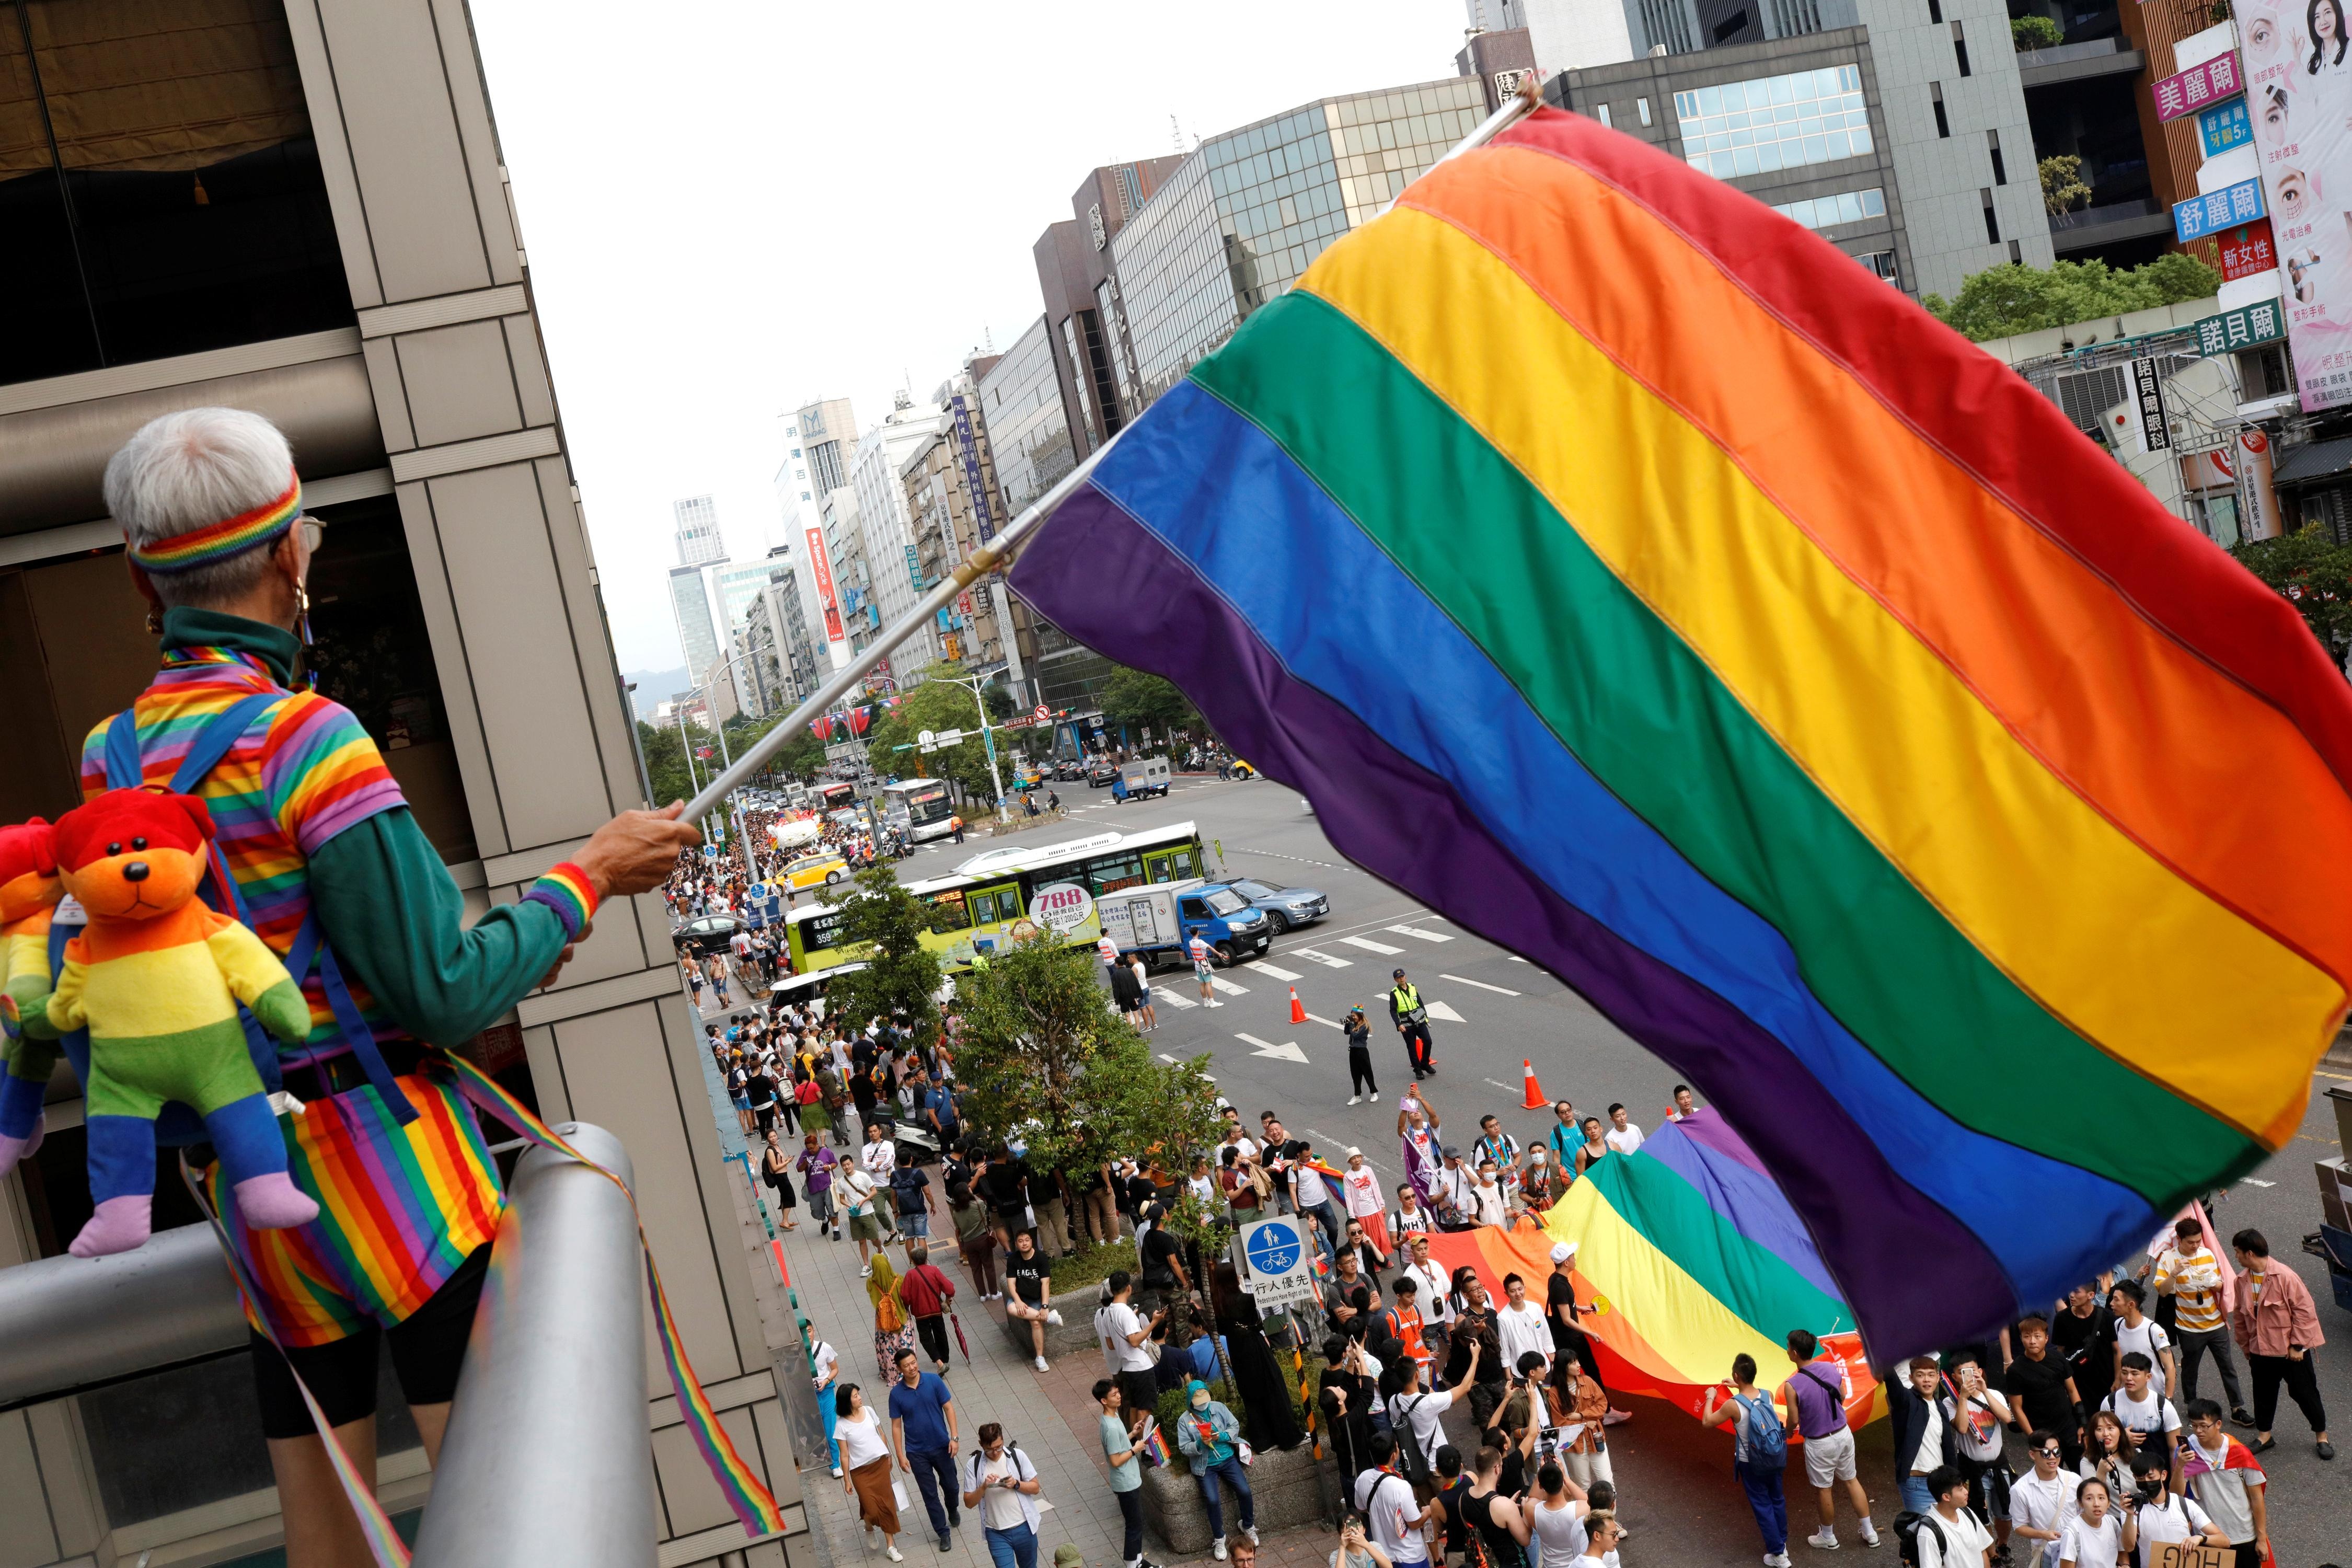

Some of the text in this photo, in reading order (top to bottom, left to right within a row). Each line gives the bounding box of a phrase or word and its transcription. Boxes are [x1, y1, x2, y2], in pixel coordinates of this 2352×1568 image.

[2254, 63, 2284, 84] 眼部整形
[2159, 56, 2234, 117] 美麗爾
[2207, 106, 2244, 132] 舒麗爾
[2268, 143, 2299, 163] 注射微整
[2180, 182, 2257, 235] 舒麗爾
[2282, 223, 2312, 242] 光電治療
[2223, 239, 2269, 268] 新女性
[2293, 304, 2325, 321] 整形手術
[2199, 304, 2276, 356] 諾貝爾
[2305, 372, 2347, 390] 雙眼皮 眼袋
[2136, 360, 2166, 450] 諾貝爾眼科
[803, 427, 826, 440] MINGYAO
[786, 426, 812, 502] 明曜百貨
[2246, 475, 2261, 521] 京星港式飲茶
[940, 503, 955, 551] 京星港式飲茶 2
[814, 545, 828, 585] SpaceCycle
[909, 560, 922, 586] 復健科
[1005, 718, 1027, 727] 國父紀念館
[1037, 889, 1082, 912] 788
[1053, 905, 1085, 916] 拯救自己!
[1401, 1219, 1425, 1231] WHY
[1255, 1274, 1309, 1295] 行人優先
[1257, 1296, 1278, 1305] Pedestrians
[1288, 1290, 1298, 1299] Right
